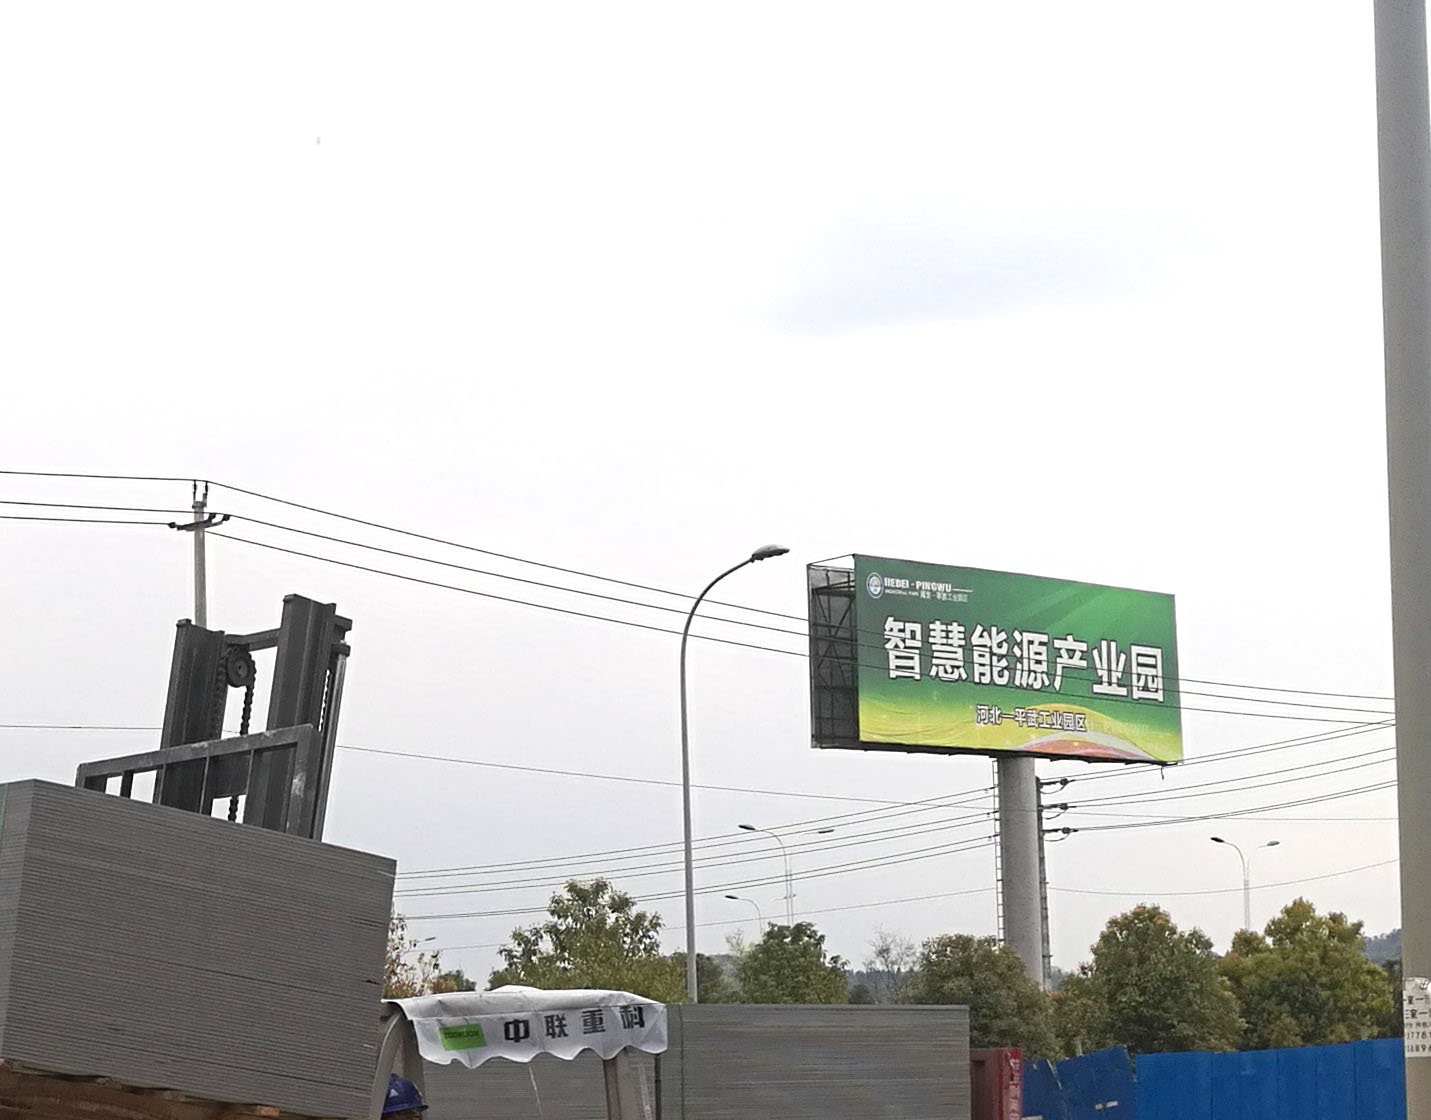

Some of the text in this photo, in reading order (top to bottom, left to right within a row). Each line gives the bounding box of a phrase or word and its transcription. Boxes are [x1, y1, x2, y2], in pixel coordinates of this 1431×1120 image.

[883, 615, 1164, 703] 智慧能源产业园
[504, 1005, 646, 1043] 中联重科
